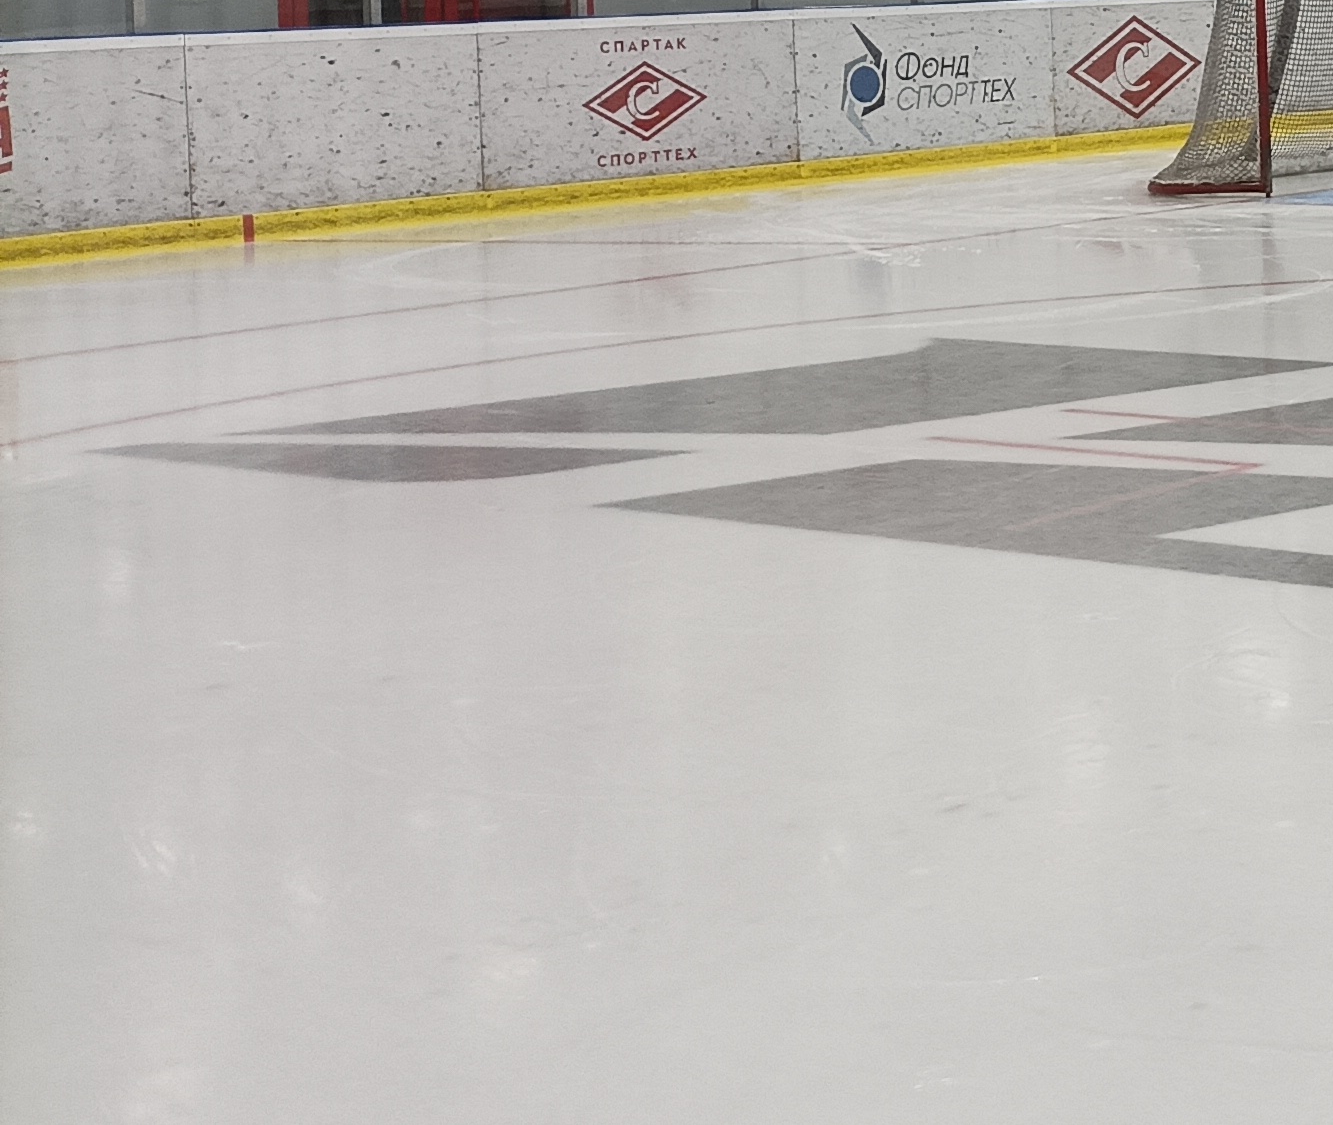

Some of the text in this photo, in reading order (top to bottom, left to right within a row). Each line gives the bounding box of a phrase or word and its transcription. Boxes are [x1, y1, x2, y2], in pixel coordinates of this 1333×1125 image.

[600, 37, 687, 54] СПАРТАК
[895, 52, 969, 81] Фонд
[897, 77, 1017, 111] СПОРТТЕХ
[597, 147, 698, 167] СПОРТТЕХ
